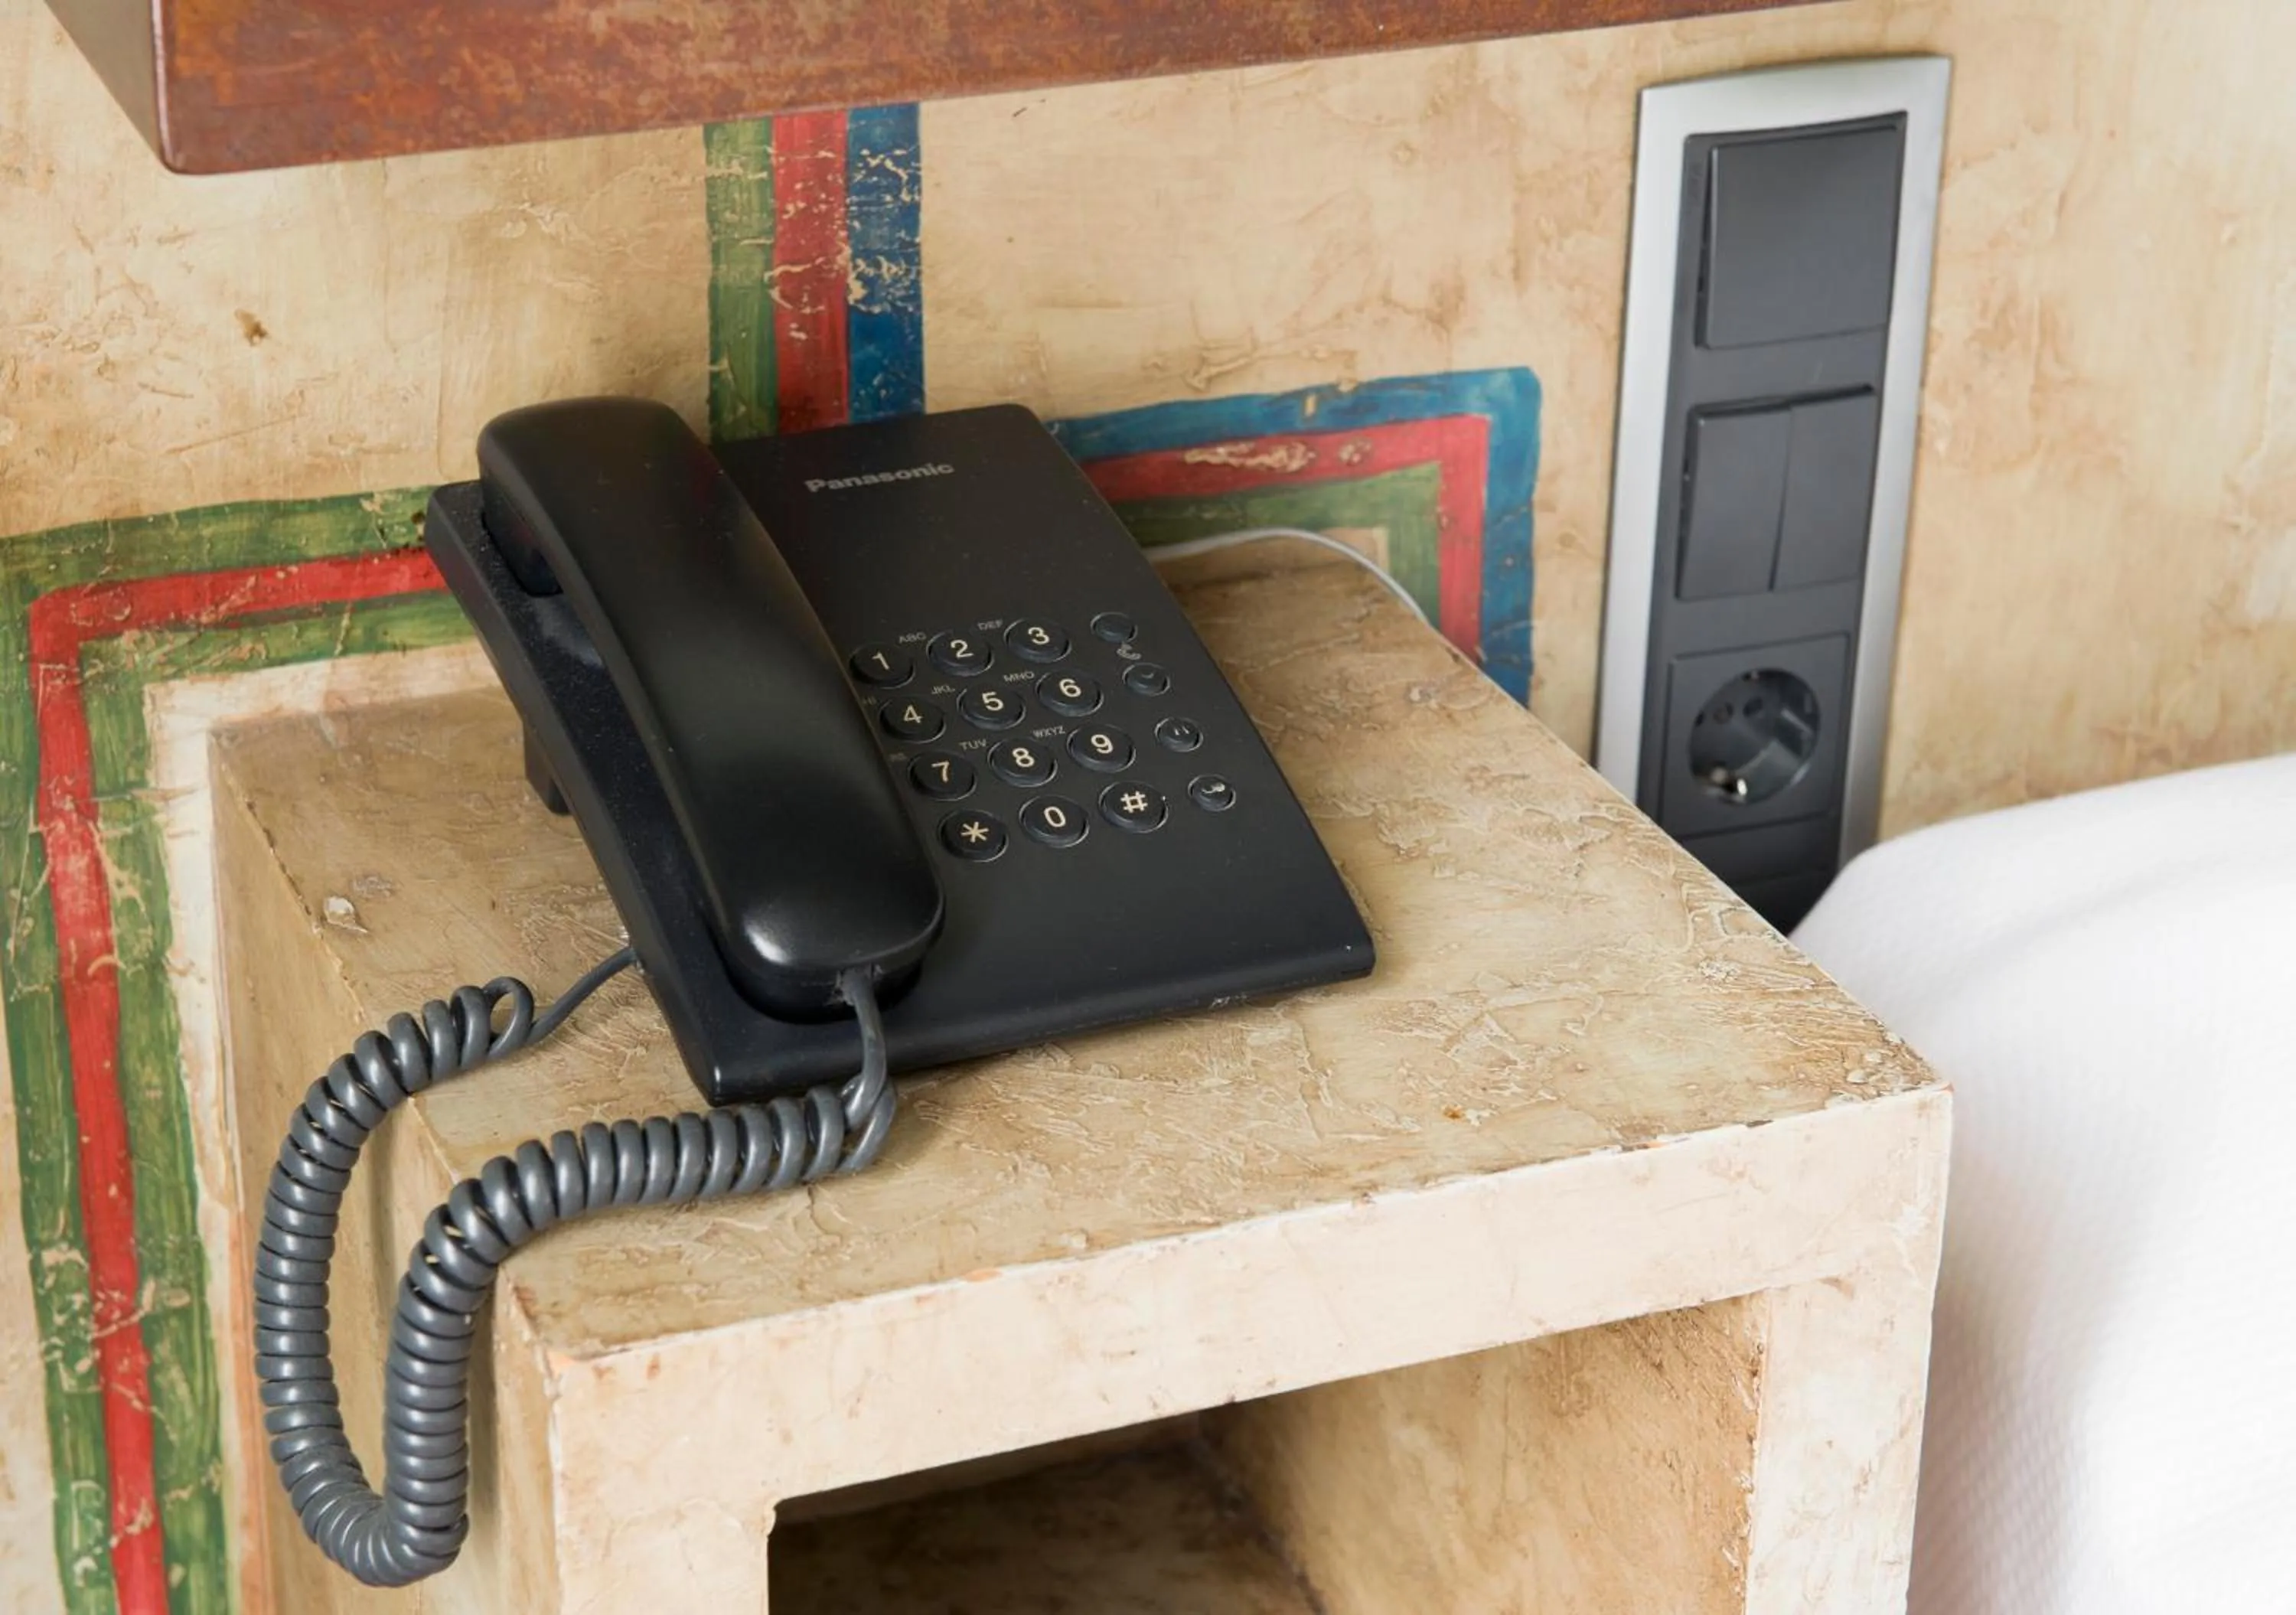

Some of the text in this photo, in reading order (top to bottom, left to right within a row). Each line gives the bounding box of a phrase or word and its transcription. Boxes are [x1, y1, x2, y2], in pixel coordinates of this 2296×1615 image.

[804, 462, 955, 492] Panasonic
[977, 619, 1003, 631] DEF
[1027, 626, 1050, 645] 3
[950, 639, 974, 659] 2
[871, 651, 890, 670] 1
[1058, 678, 1082, 698] 6
[981, 691, 1004, 711] 5
[902, 705, 922, 724] 4
[959, 738, 988, 750] TUV
[1091, 733, 1114, 754] 9
[1012, 747, 1035, 768] 8
[931, 760, 951, 783] 7
[1043, 805, 1066, 827] 0
